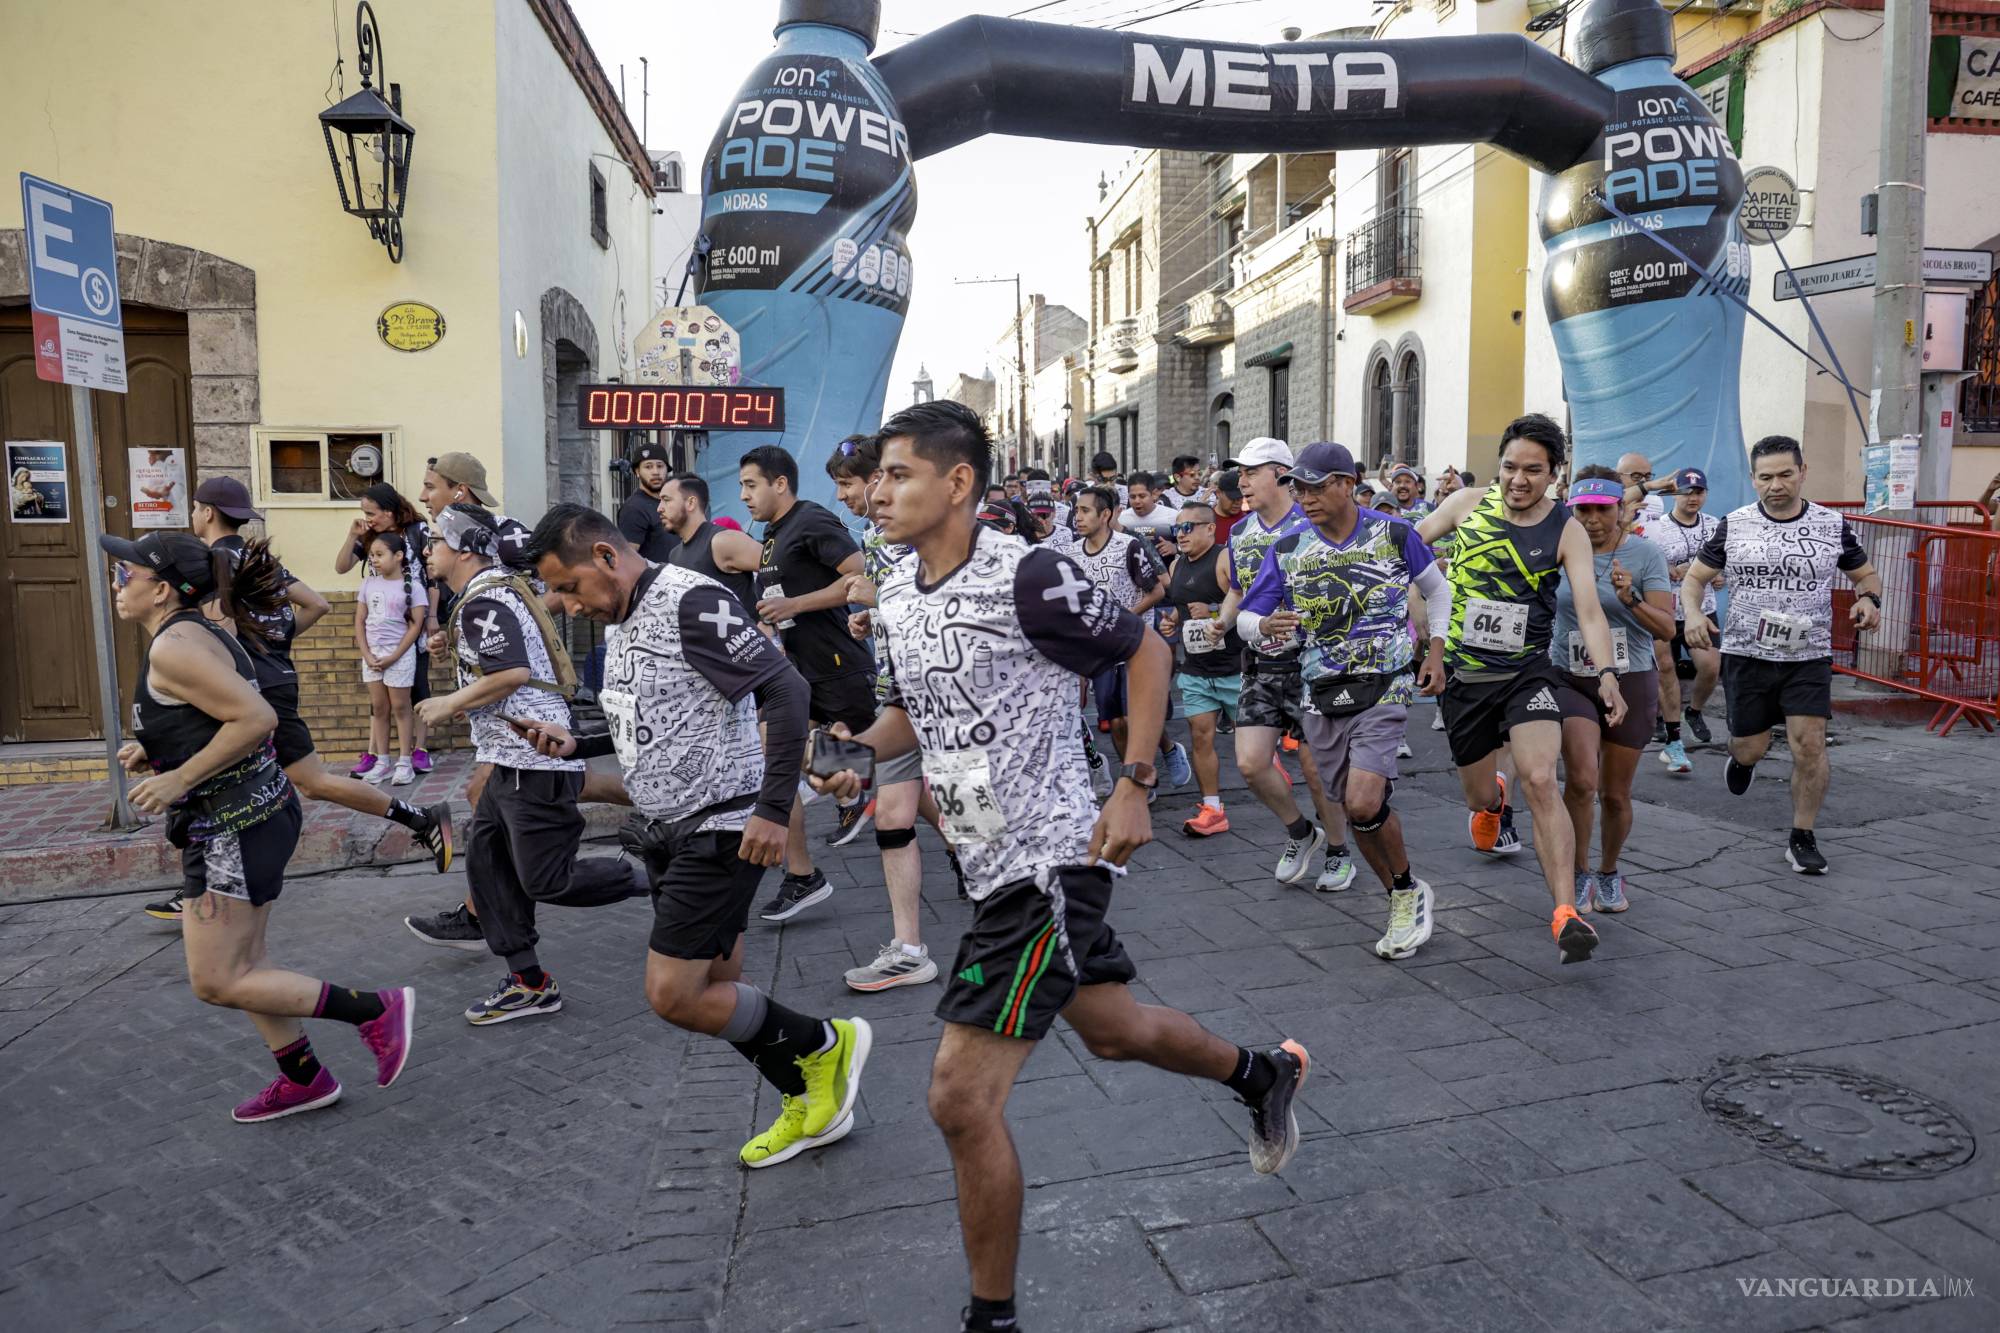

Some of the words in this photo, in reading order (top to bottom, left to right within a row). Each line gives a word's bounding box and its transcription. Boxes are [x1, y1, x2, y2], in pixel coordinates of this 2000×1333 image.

[1131, 42, 1399, 111] META
[798, 88, 827, 97] CALCIO
[726, 98, 911, 166] POWER
[1604, 122, 1627, 132] SODIO
[1632, 117, 1664, 127] POTASIO
[723, 193, 768, 212] MORAS
[1740, 205, 1792, 220] COFFEE
[29, 185, 79, 279] E
[711, 257, 725, 267] NET.
[728, 246, 757, 266] 600
[760, 245, 780, 266] ml
[1609, 268, 1631, 279] CONT.
[1633, 261, 1666, 282] 600
[1669, 261, 1688, 277] ml
[1953, 261, 1977, 271] BRAVO
[1610, 275, 1630, 287] NET.
[1800, 273, 1829, 287] BENITO
[1831, 268, 1862, 282] JUAREZ
[1733, 566, 1801, 578] URBAN
[1473, 613, 1503, 634] 616
[1512, 622, 1523, 636] 616
[1765, 622, 1792, 642] 114
[725, 626, 757, 655] AÑOS
[1572, 644, 1589, 663] 10
[1616, 642, 1625, 661] 1039
[1332, 698, 1355, 707] adidas
[972, 785, 993, 811] 336
